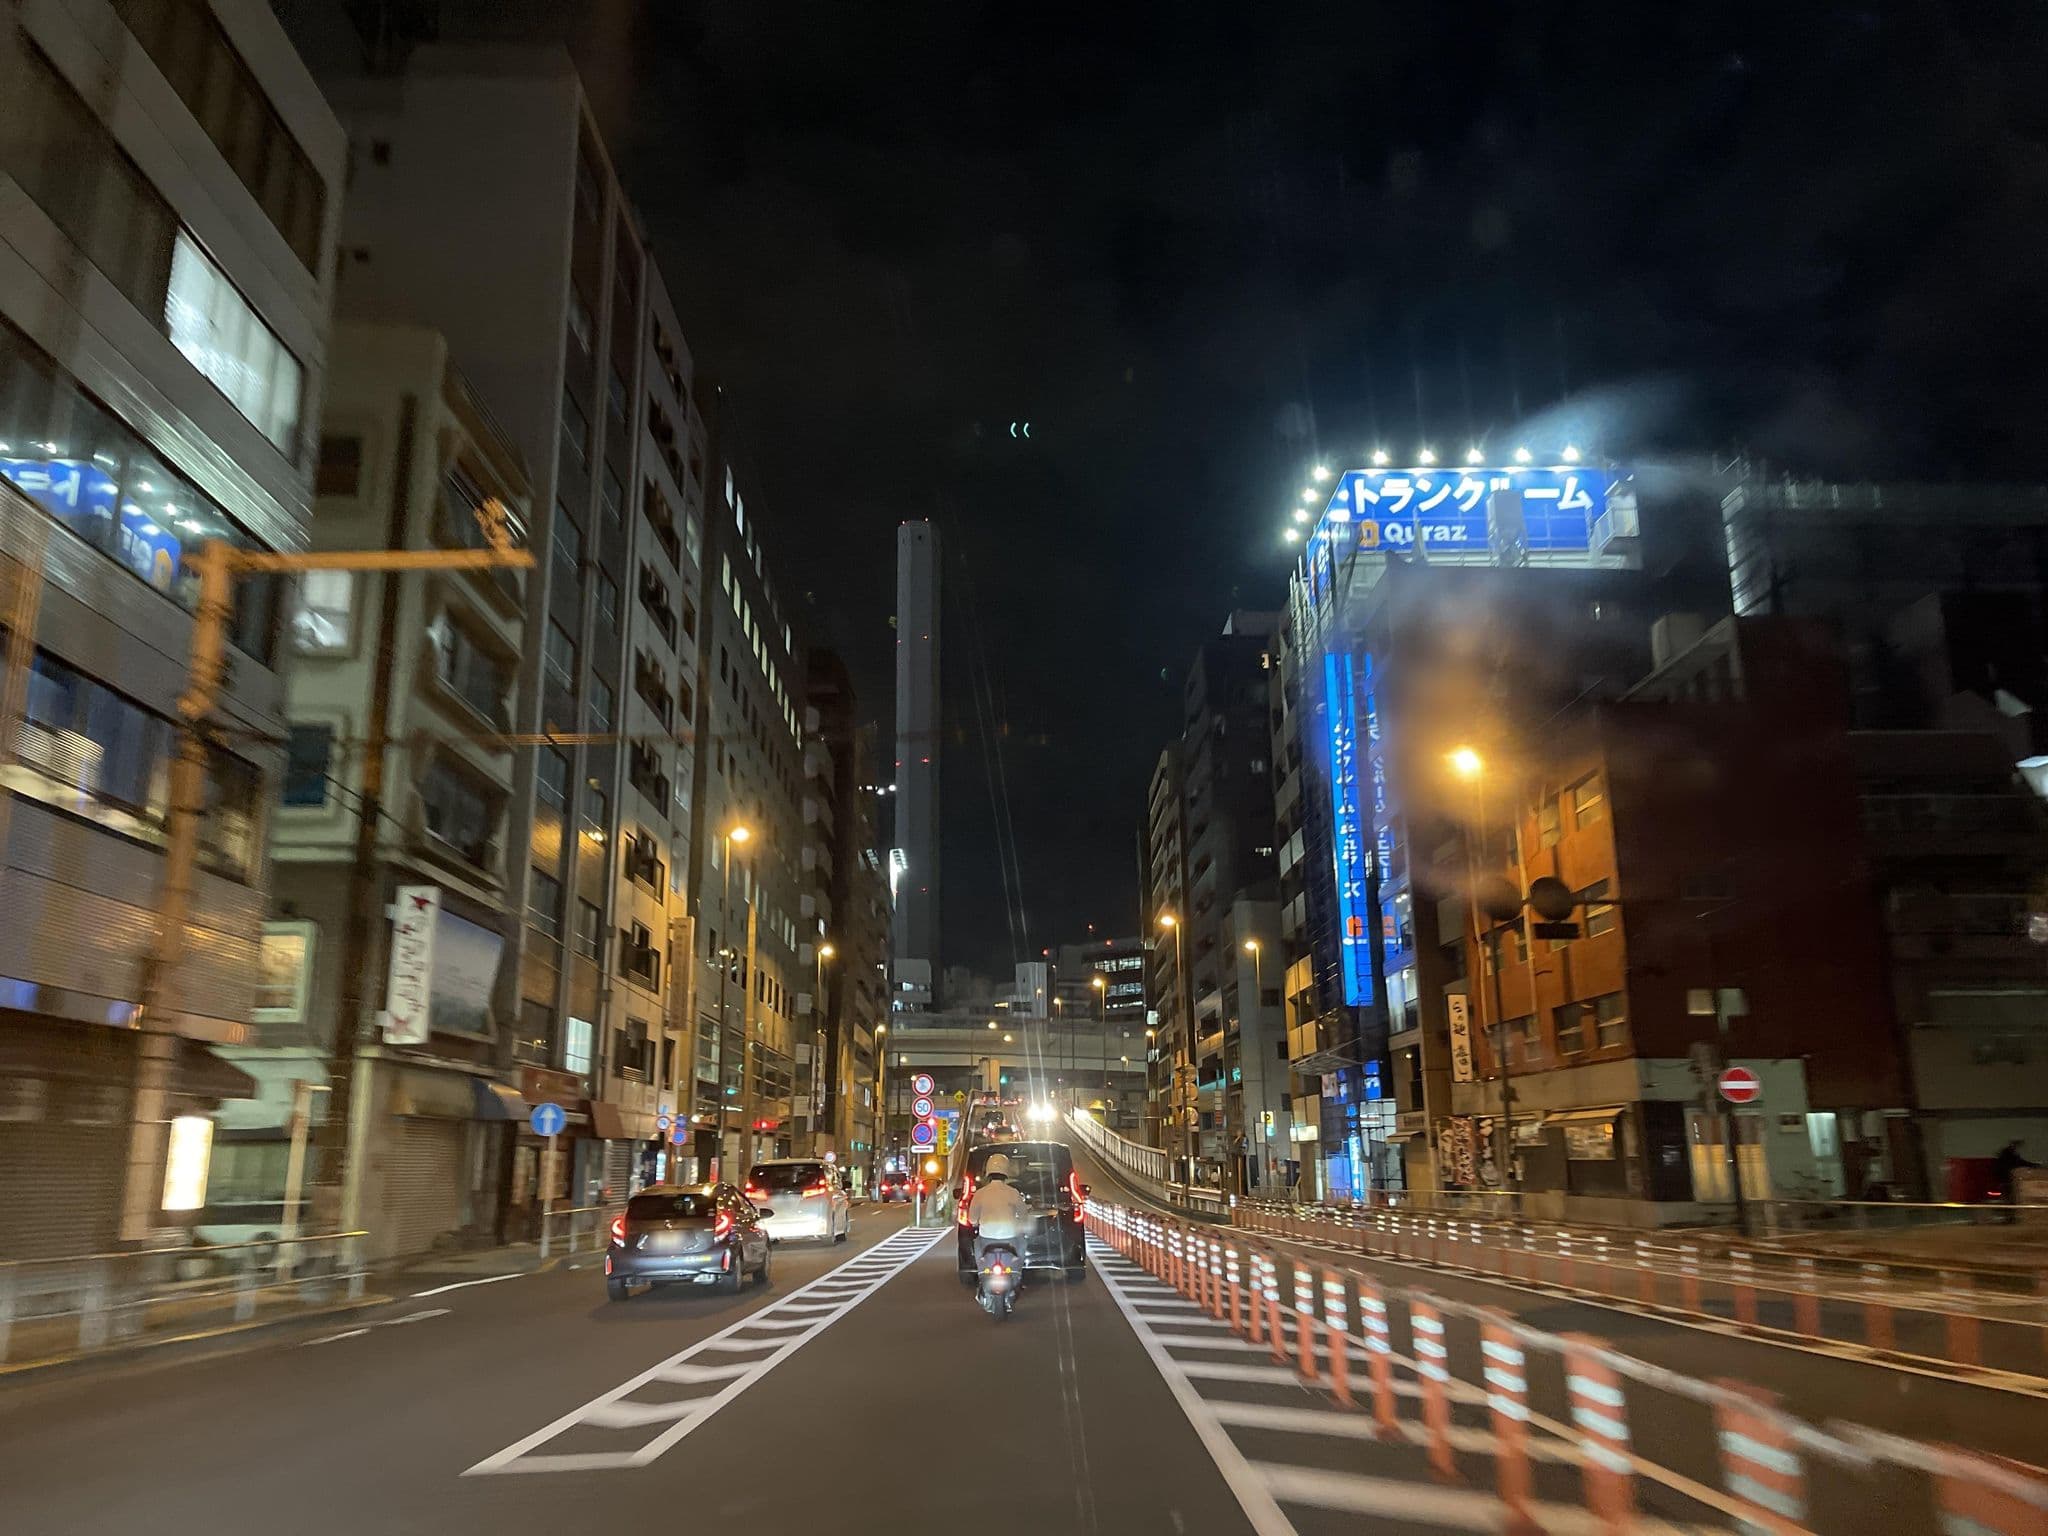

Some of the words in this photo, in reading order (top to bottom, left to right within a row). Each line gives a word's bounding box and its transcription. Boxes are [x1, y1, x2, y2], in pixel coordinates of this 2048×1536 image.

[1354, 477, 1593, 513] トランクーム
[917, 1102, 929, 1113] 50
